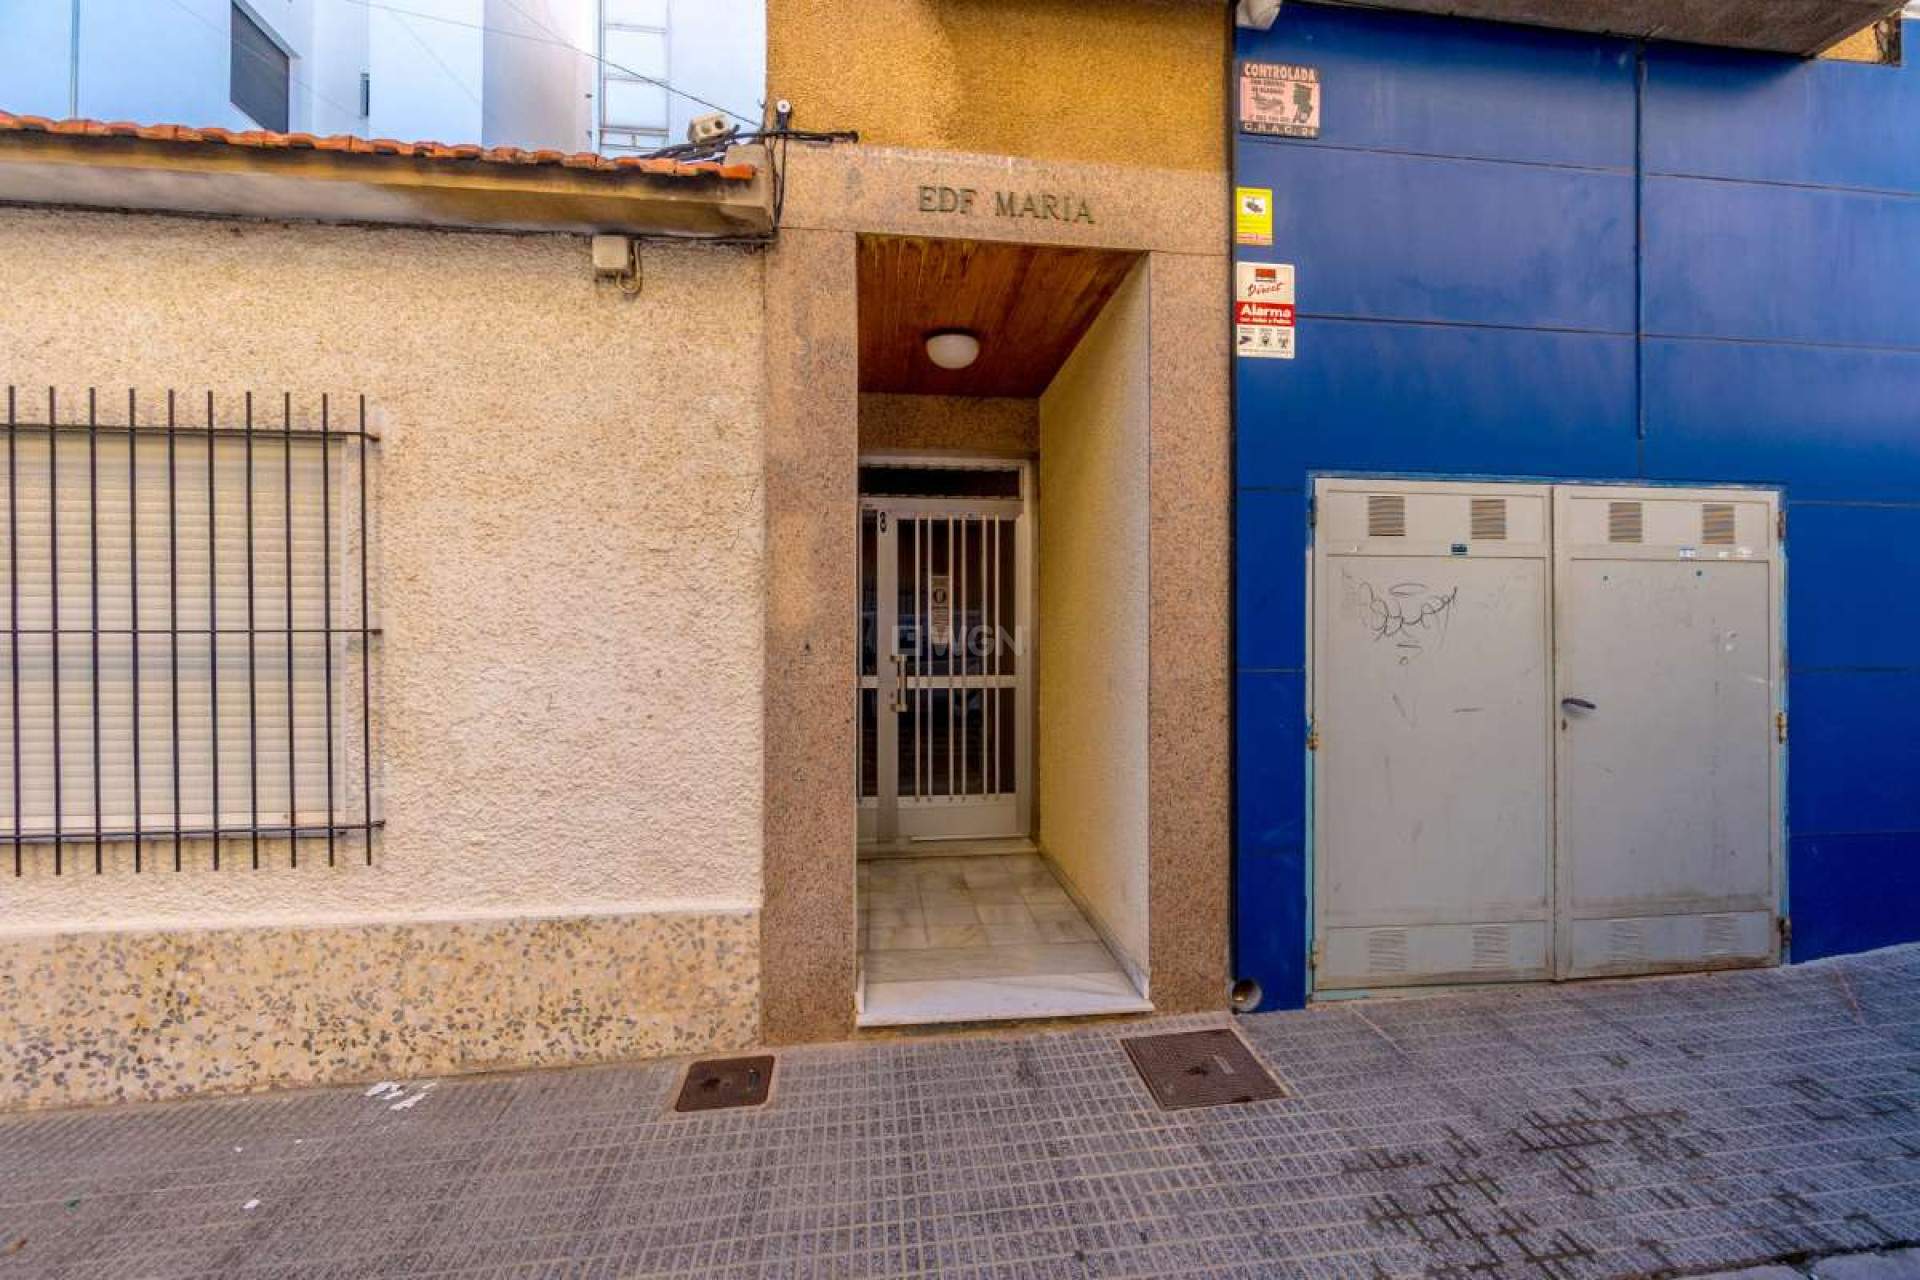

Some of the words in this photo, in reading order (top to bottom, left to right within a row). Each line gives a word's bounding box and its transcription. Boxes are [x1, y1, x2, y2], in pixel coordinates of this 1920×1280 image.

[1244, 63, 1316, 82] CONTROLADA
[918, 186, 977, 214] EDF
[1241, 303, 1292, 318] Alarma
